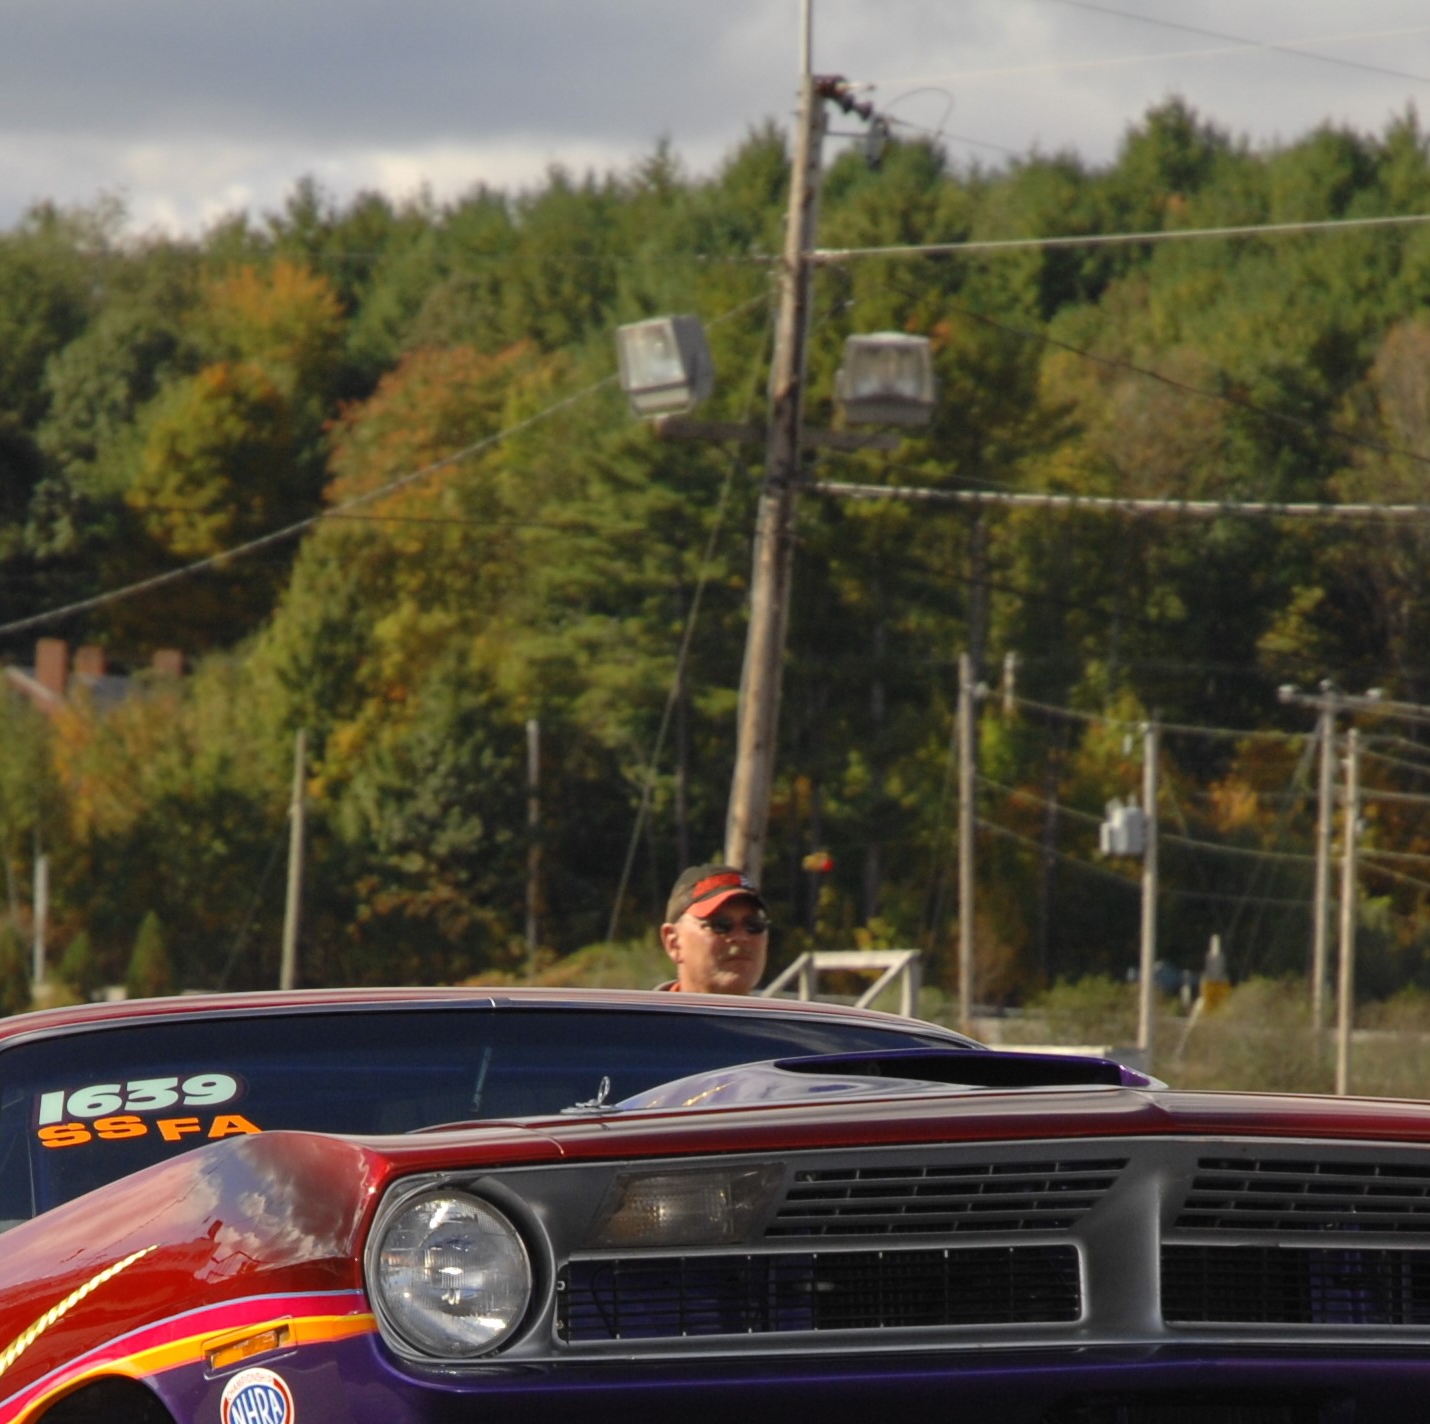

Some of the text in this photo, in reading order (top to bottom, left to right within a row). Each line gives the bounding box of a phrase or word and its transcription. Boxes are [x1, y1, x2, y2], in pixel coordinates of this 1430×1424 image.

[38, 1073, 237, 1126] 1639
[37, 1114, 264, 1148] SS FA
